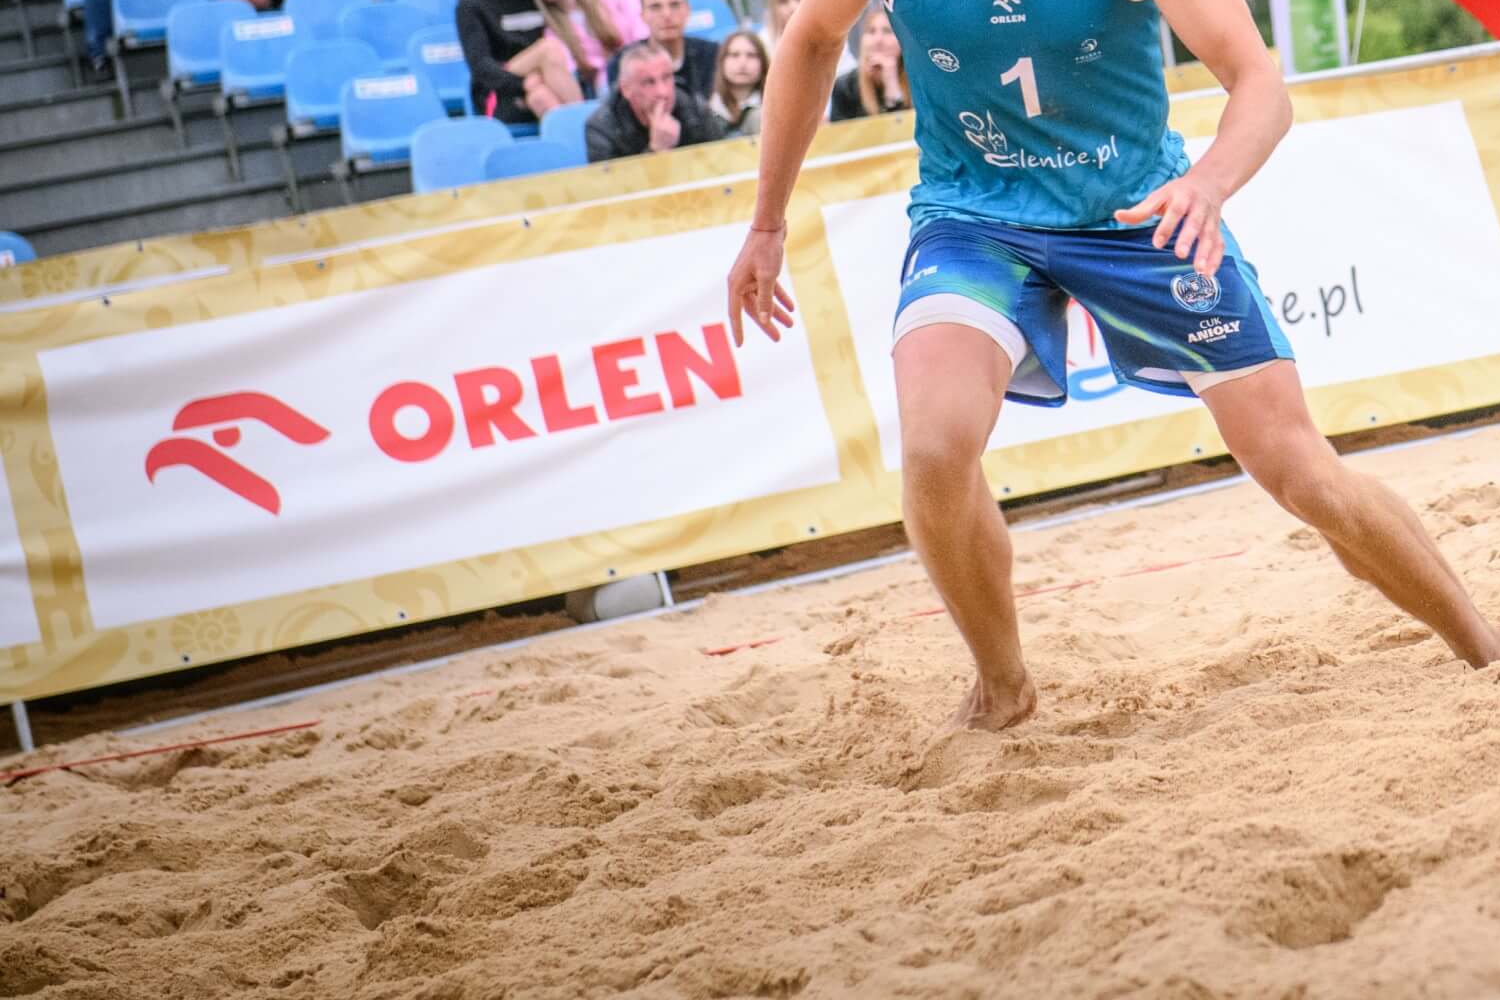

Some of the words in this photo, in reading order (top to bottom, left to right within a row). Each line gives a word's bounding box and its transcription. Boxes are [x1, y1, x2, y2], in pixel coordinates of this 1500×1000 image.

[989, 14, 1027, 25] ORLEN
[1000, 56, 1042, 118] 1
[1187, 319, 1241, 344] ANIOŁY
[1199, 317, 1222, 330] CUK
[368, 322, 743, 463] ORLEN
